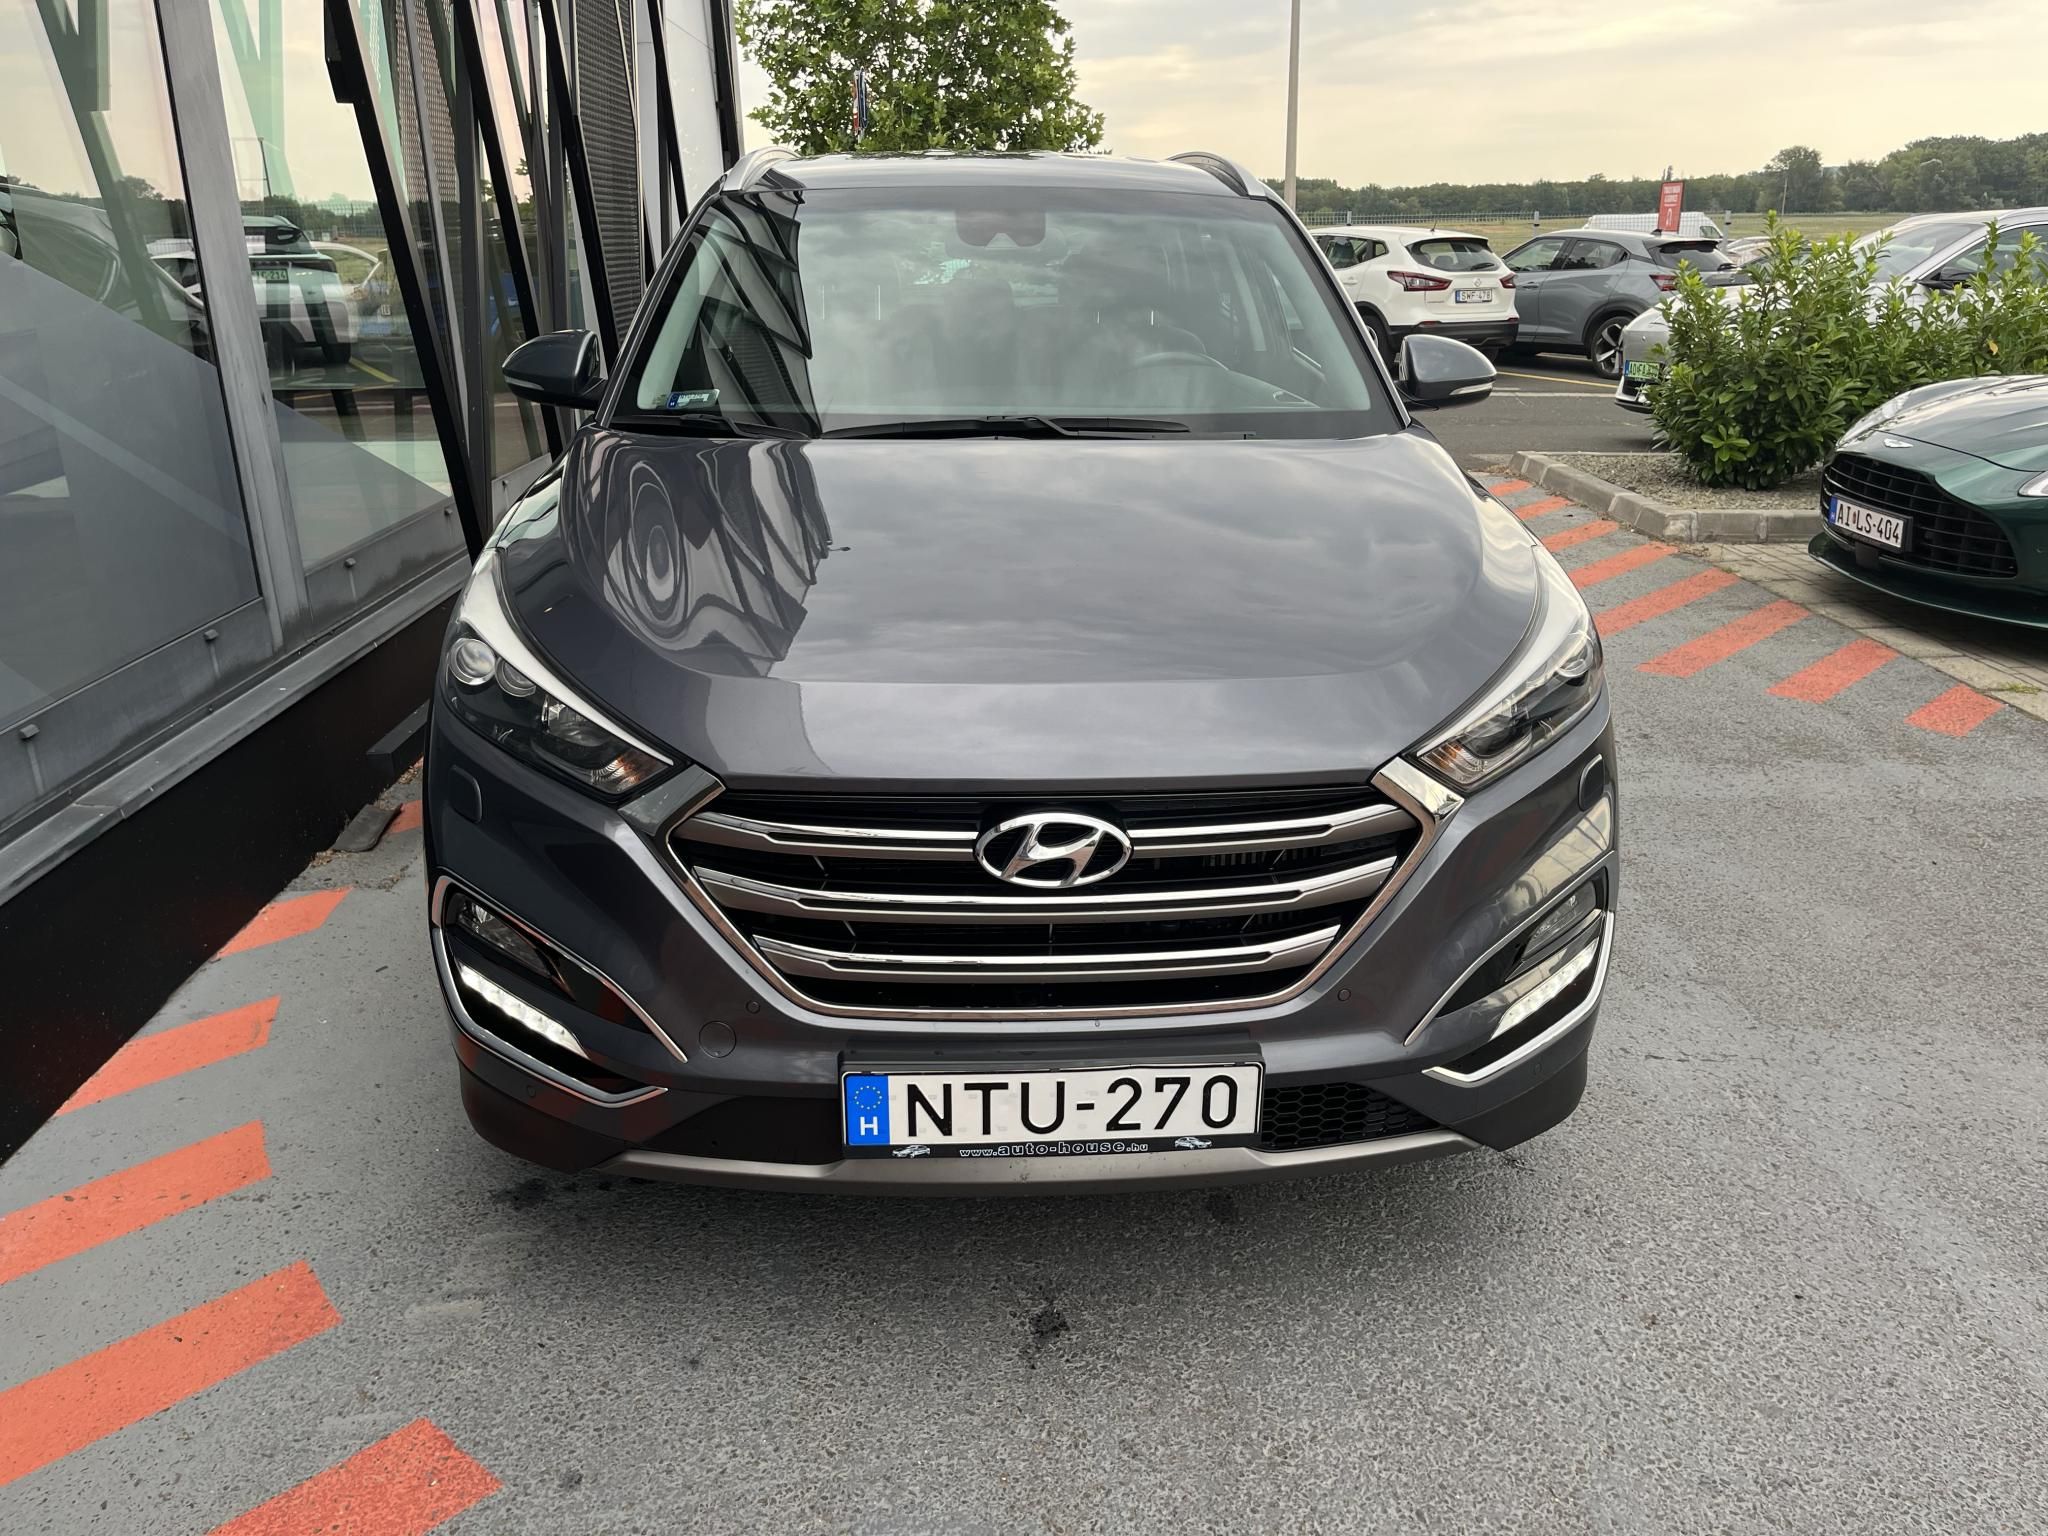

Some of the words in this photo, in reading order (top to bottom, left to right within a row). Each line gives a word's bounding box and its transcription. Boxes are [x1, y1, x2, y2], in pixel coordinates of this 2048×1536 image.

[907, 1074, 1238, 1137] NTU-270
[860, 1116, 879, 1136] H
[959, 1141, 1149, 1157] www.auto-house.hu
